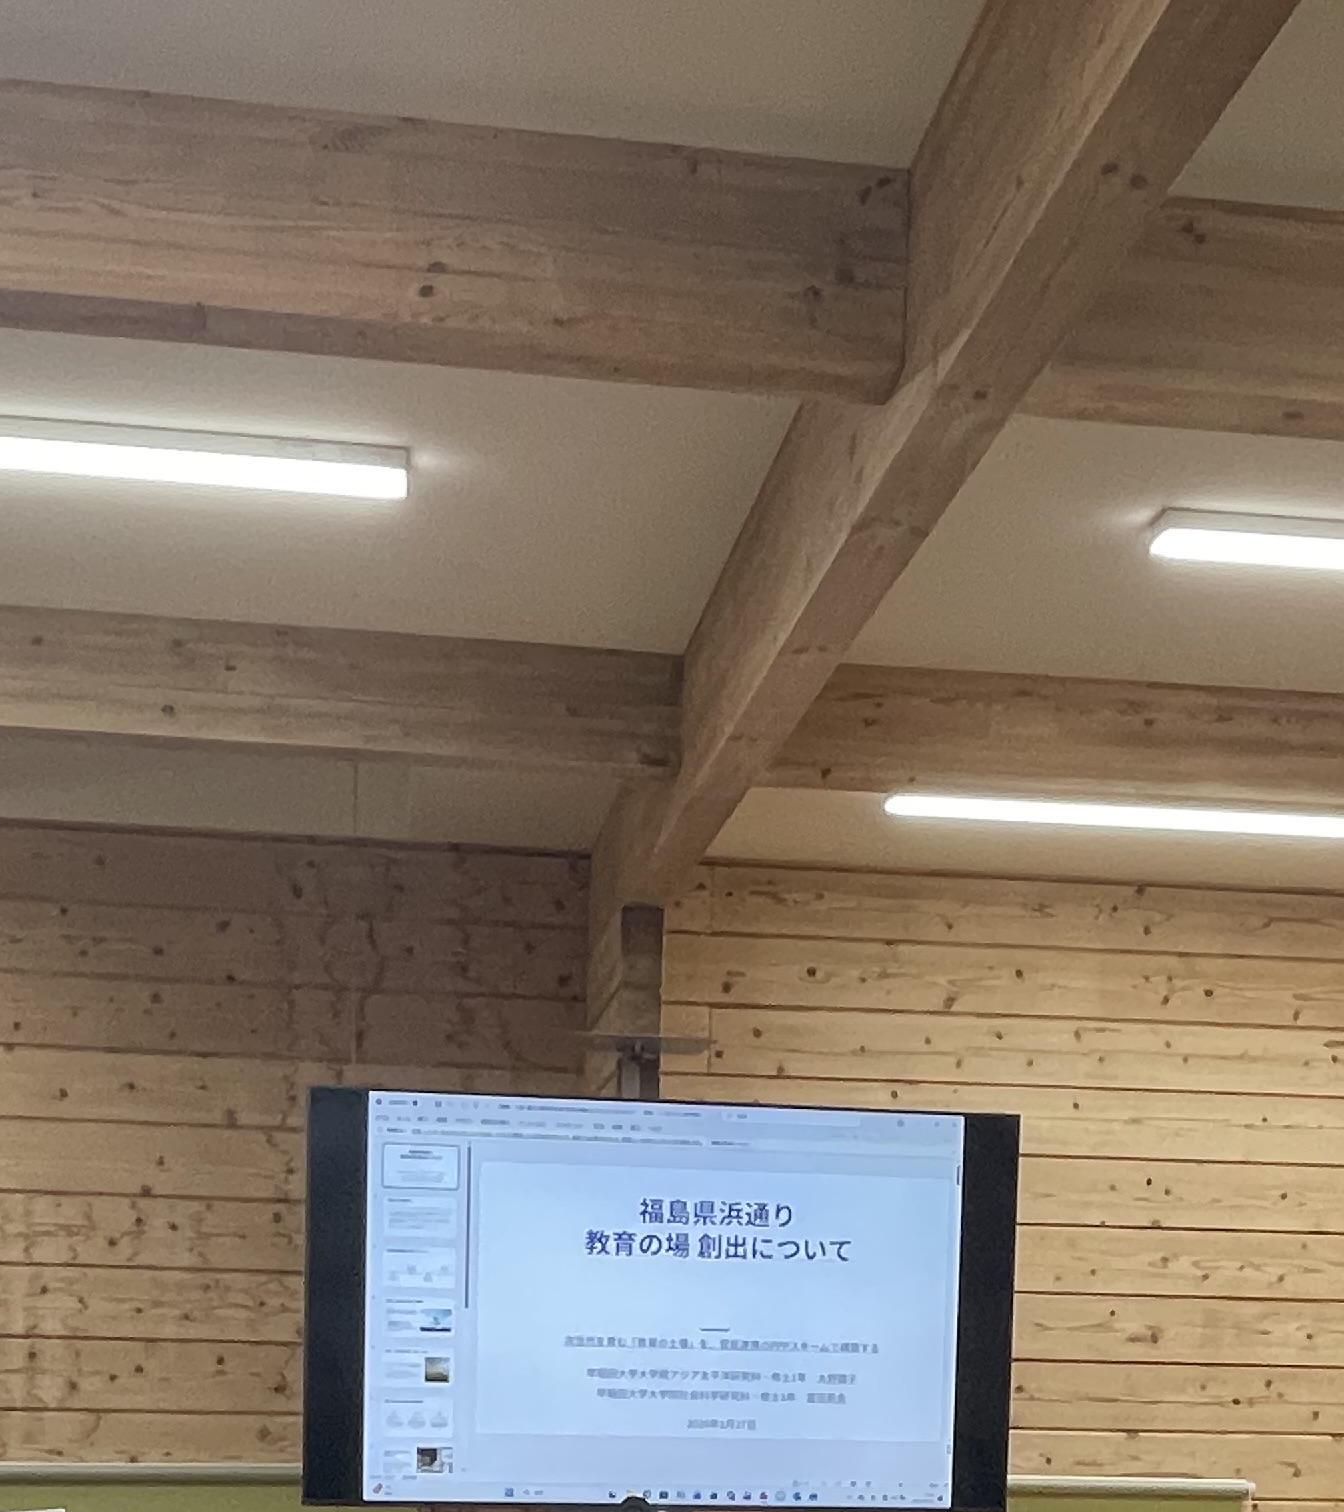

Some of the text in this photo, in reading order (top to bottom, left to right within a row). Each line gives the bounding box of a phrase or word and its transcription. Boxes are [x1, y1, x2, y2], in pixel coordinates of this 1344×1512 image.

[639, 1197, 793, 1228] 福島県浜通り
